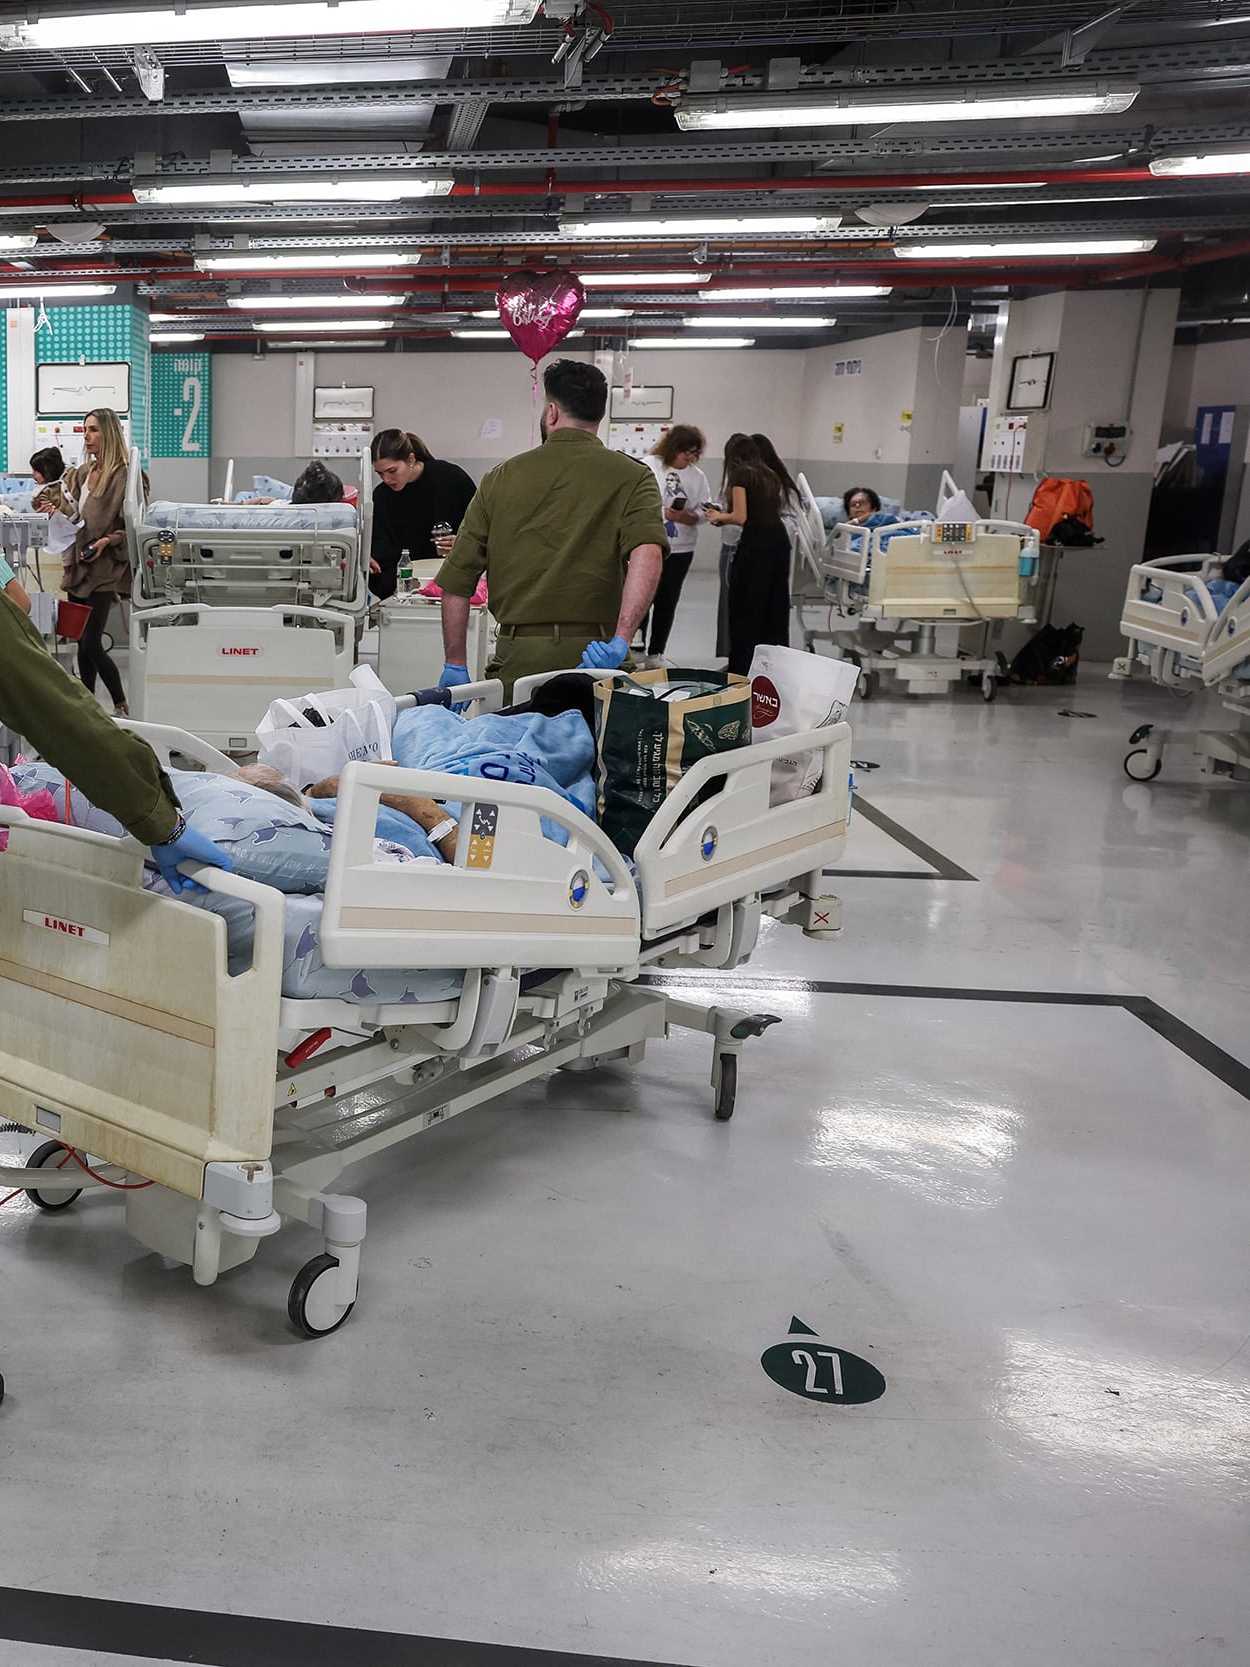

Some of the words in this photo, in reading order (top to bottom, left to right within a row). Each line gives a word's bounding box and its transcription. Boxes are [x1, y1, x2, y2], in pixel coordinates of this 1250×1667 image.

[173, 358, 202, 376] קומה
[173, 376, 202, 452] -2
[221, 647, 259, 656] LINET
[44, 916, 86, 937] LINET
[790, 1349, 844, 1395] 27
